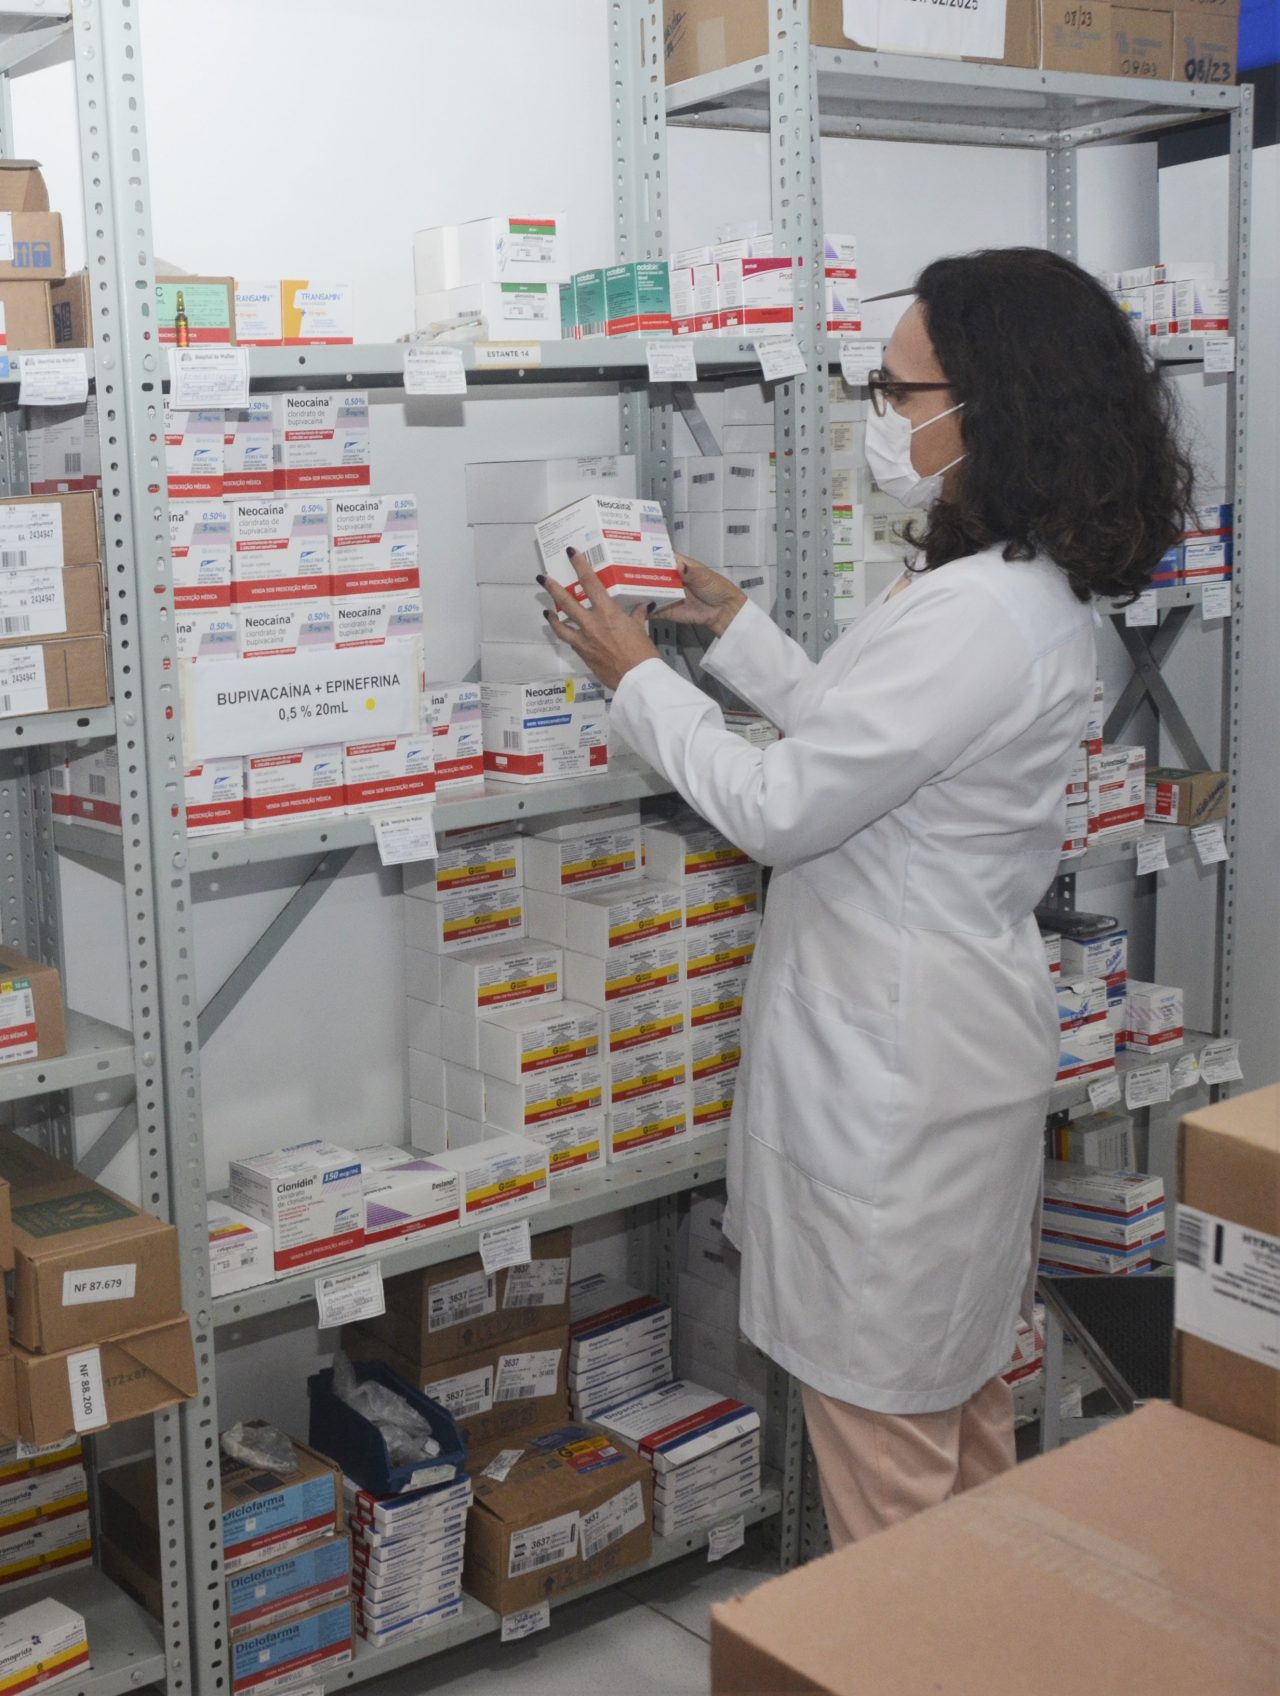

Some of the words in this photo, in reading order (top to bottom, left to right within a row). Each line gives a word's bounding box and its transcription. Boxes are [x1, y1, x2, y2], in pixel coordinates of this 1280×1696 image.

[1185, 57, 1231, 83] 08/23
[301, 292, 340, 301] TRANSAMIN
[487, 350, 520, 358] ESTANTE
[217, 684, 311, 706] BUPIVACAÍNA
[315, 684, 322, 694] +
[326, 673, 400, 694] EPINEFRINA
[278, 708, 297, 722] 0,5
[300, 705, 311, 717] %
[315, 701, 349, 716] 20mL
[9, 1030, 28, 1040] MÉDICA
[324, 1171, 339, 1182] 150
[276, 1178, 314, 1193] Clonidin
[74, 1282, 87, 1293] NF
[89, 1278, 122, 1291] 87.679
[448, 1290, 468, 1304] 3637
[504, 1358, 520, 1368] 3637
[79, 1364, 89, 1378] NF
[81, 1381, 93, 1415] 88.200
[531, 1536, 551, 1549] 3637
[231, 1560, 296, 1589] Diclofarma
[236, 1625, 300, 1653] Diclofarma
